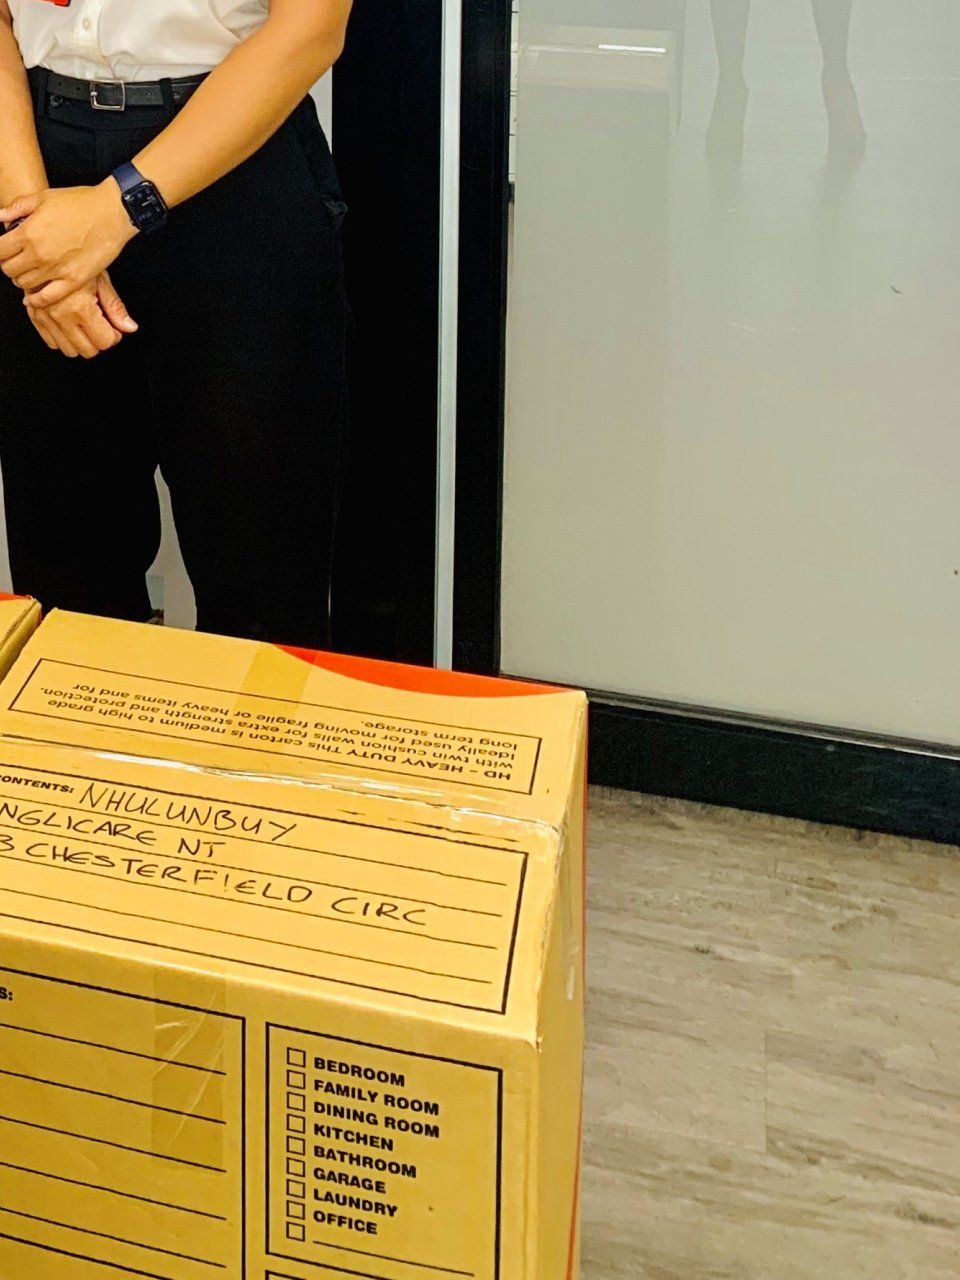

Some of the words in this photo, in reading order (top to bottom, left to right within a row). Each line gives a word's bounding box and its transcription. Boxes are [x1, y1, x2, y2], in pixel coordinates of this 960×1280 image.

[71, 683, 96, 694] for
[97, 687, 130, 699] and
[39, 686, 127, 708] protection.
[46, 698, 95, 712] grade
[132, 693, 178, 708] items
[97, 707, 134, 721] high
[128, 702, 161, 714] and
[163, 703, 233, 726] strength
[180, 700, 230, 717] heavy
[232, 710, 252, 719] or
[136, 713, 155, 724] to
[158, 717, 226, 734] medium
[236, 720, 280, 733] extra
[254, 713, 309, 729] fragile
[229, 729, 244, 739] is
[282, 727, 308, 739] for
[312, 721, 377, 739] moving
[360, 719, 428, 737] storage.
[247, 731, 303, 746] carton
[312, 732, 355, 745] walls
[380, 733, 405, 745] for
[409, 737, 452, 750] used
[432, 731, 473, 744] term
[478, 736, 518, 751] long
[307, 741, 342, 754] This
[345, 747, 397, 763] DUTY
[359, 739, 427, 756] cushion
[456, 744, 515, 761] Ideally
[400, 756, 464, 774] HEAVY
[431, 750, 470, 764] twin
[474, 757, 513, 770] with
[482, 769, 511, 781] HD
[78, 782, 297, 842] NHULUNBUY
[177, 838, 226, 859] NT
[25, 843, 312, 904] CHESTERFIELD
[331, 896, 427, 926] CIRC
[313, 1058, 404, 1085] BEDROOM
[313, 1081, 378, 1102] FAMILY
[383, 1095, 439, 1114] ROOM
[313, 1103, 378, 1124] DINING
[384, 1118, 439, 1137] ROOM
[313, 1124, 393, 1150] KITCHEN
[313, 1146, 416, 1176] BATHROOM
[313, 1168, 386, 1192] GARAGE
[313, 1190, 397, 1214] LAUNDRY
[312, 1212, 377, 1233] OFFICE
